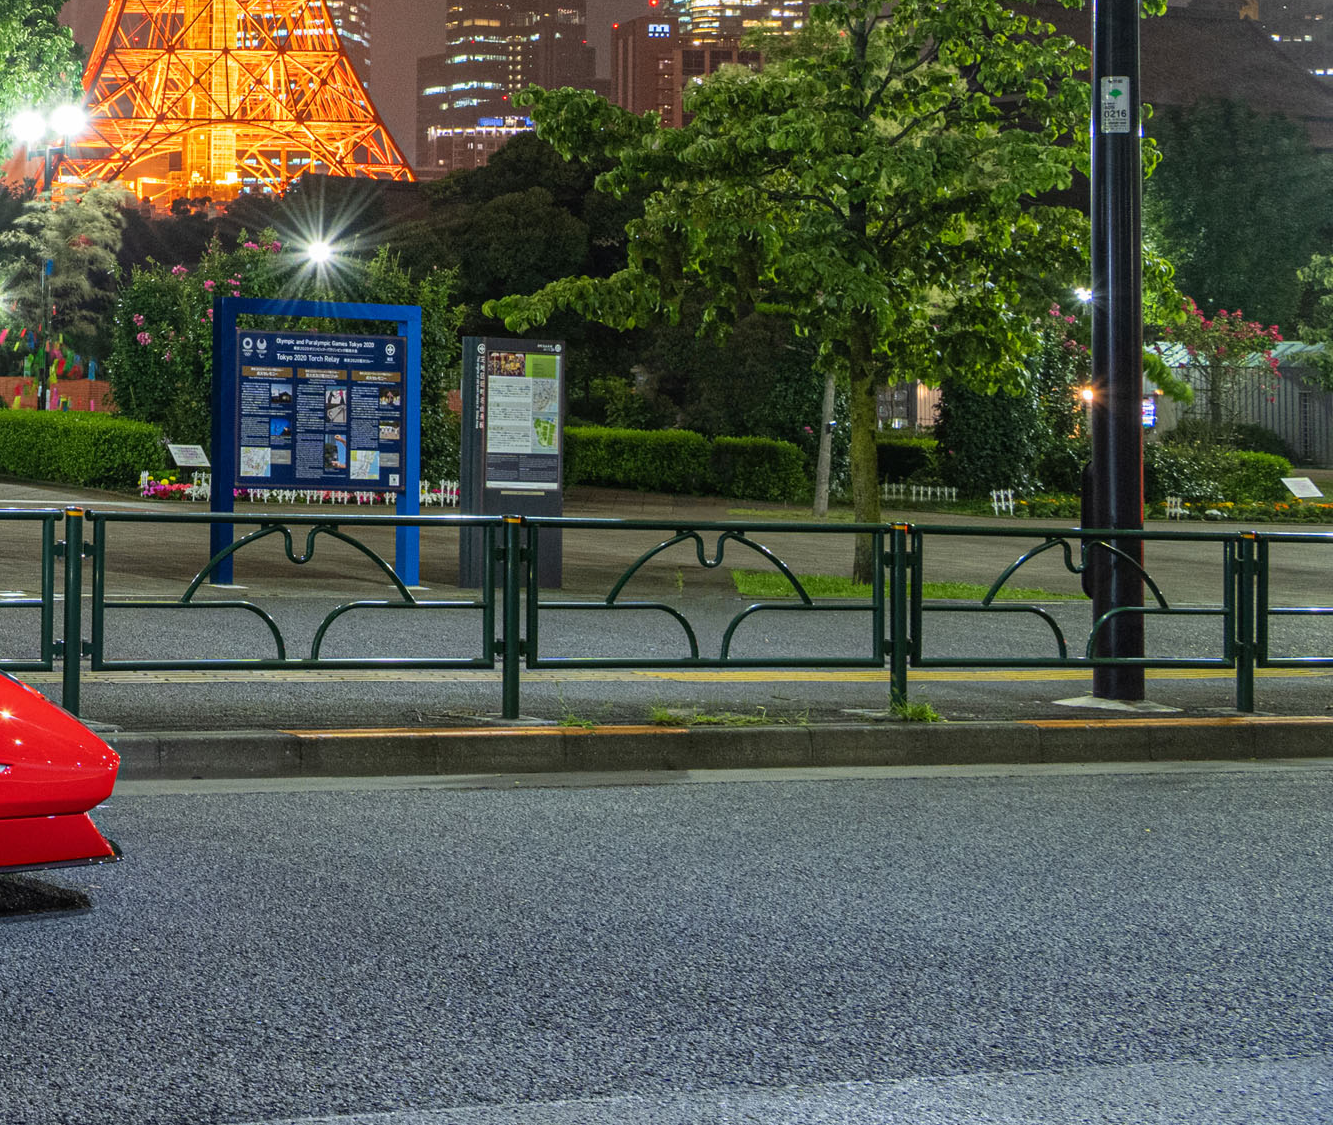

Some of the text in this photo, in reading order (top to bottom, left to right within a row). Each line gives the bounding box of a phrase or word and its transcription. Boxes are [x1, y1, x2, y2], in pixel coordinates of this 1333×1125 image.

[1104, 109, 1127, 118] 0216
[276, 337, 295, 346] Olympic
[305, 338, 331, 347] Paralympic
[332, 339, 348, 347] Games
[349, 340, 363, 348] Tokyo
[276, 353, 340, 364] Tokyo 2020 Torch Relay
